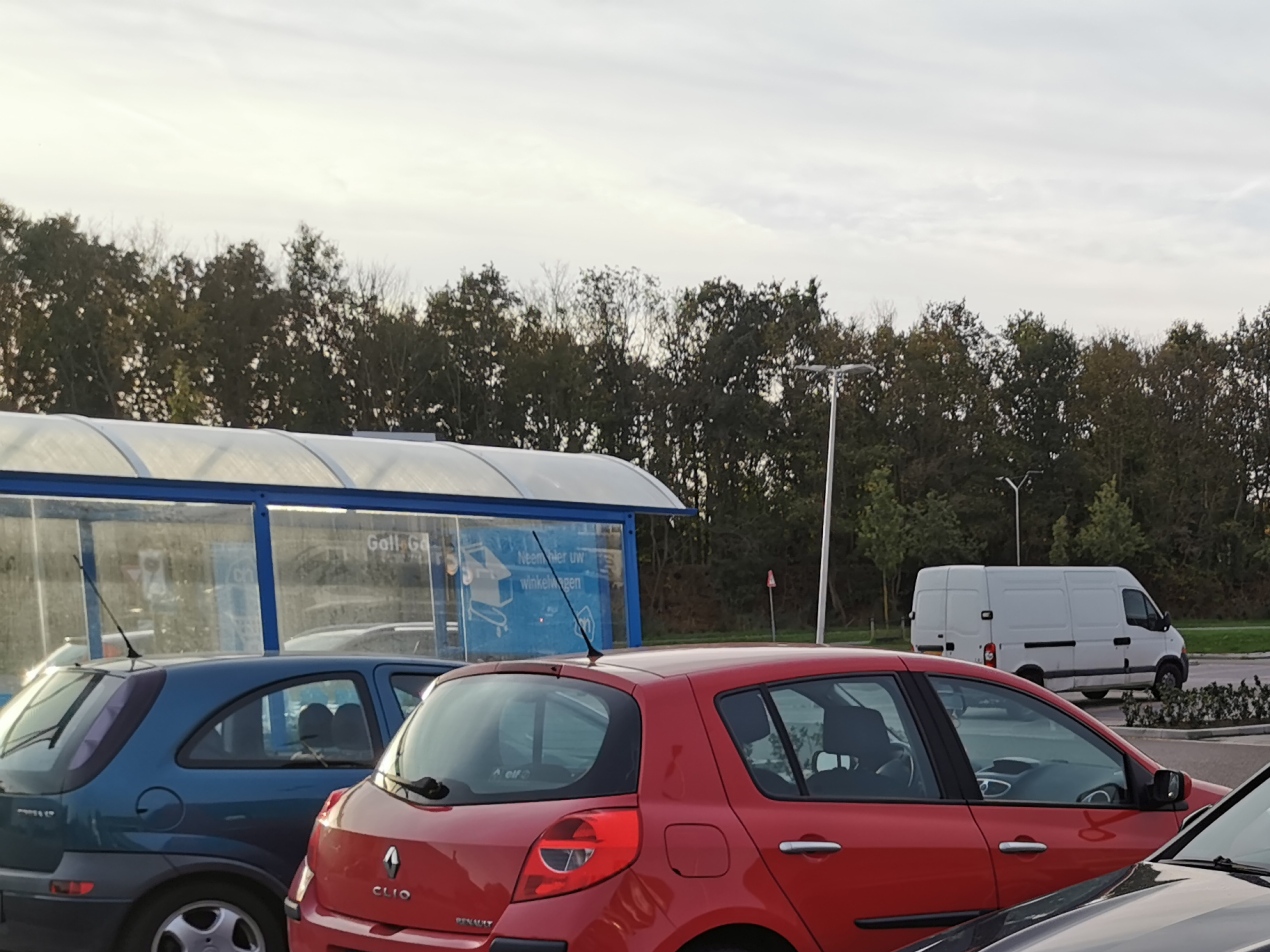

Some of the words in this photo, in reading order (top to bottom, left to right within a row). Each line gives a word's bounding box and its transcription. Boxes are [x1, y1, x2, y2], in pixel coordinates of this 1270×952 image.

[518, 551, 546, 565] Neem
[570, 551, 585, 564] uw
[372, 886, 411, 900] CLIO
[456, 917, 493, 928] RENAULT
